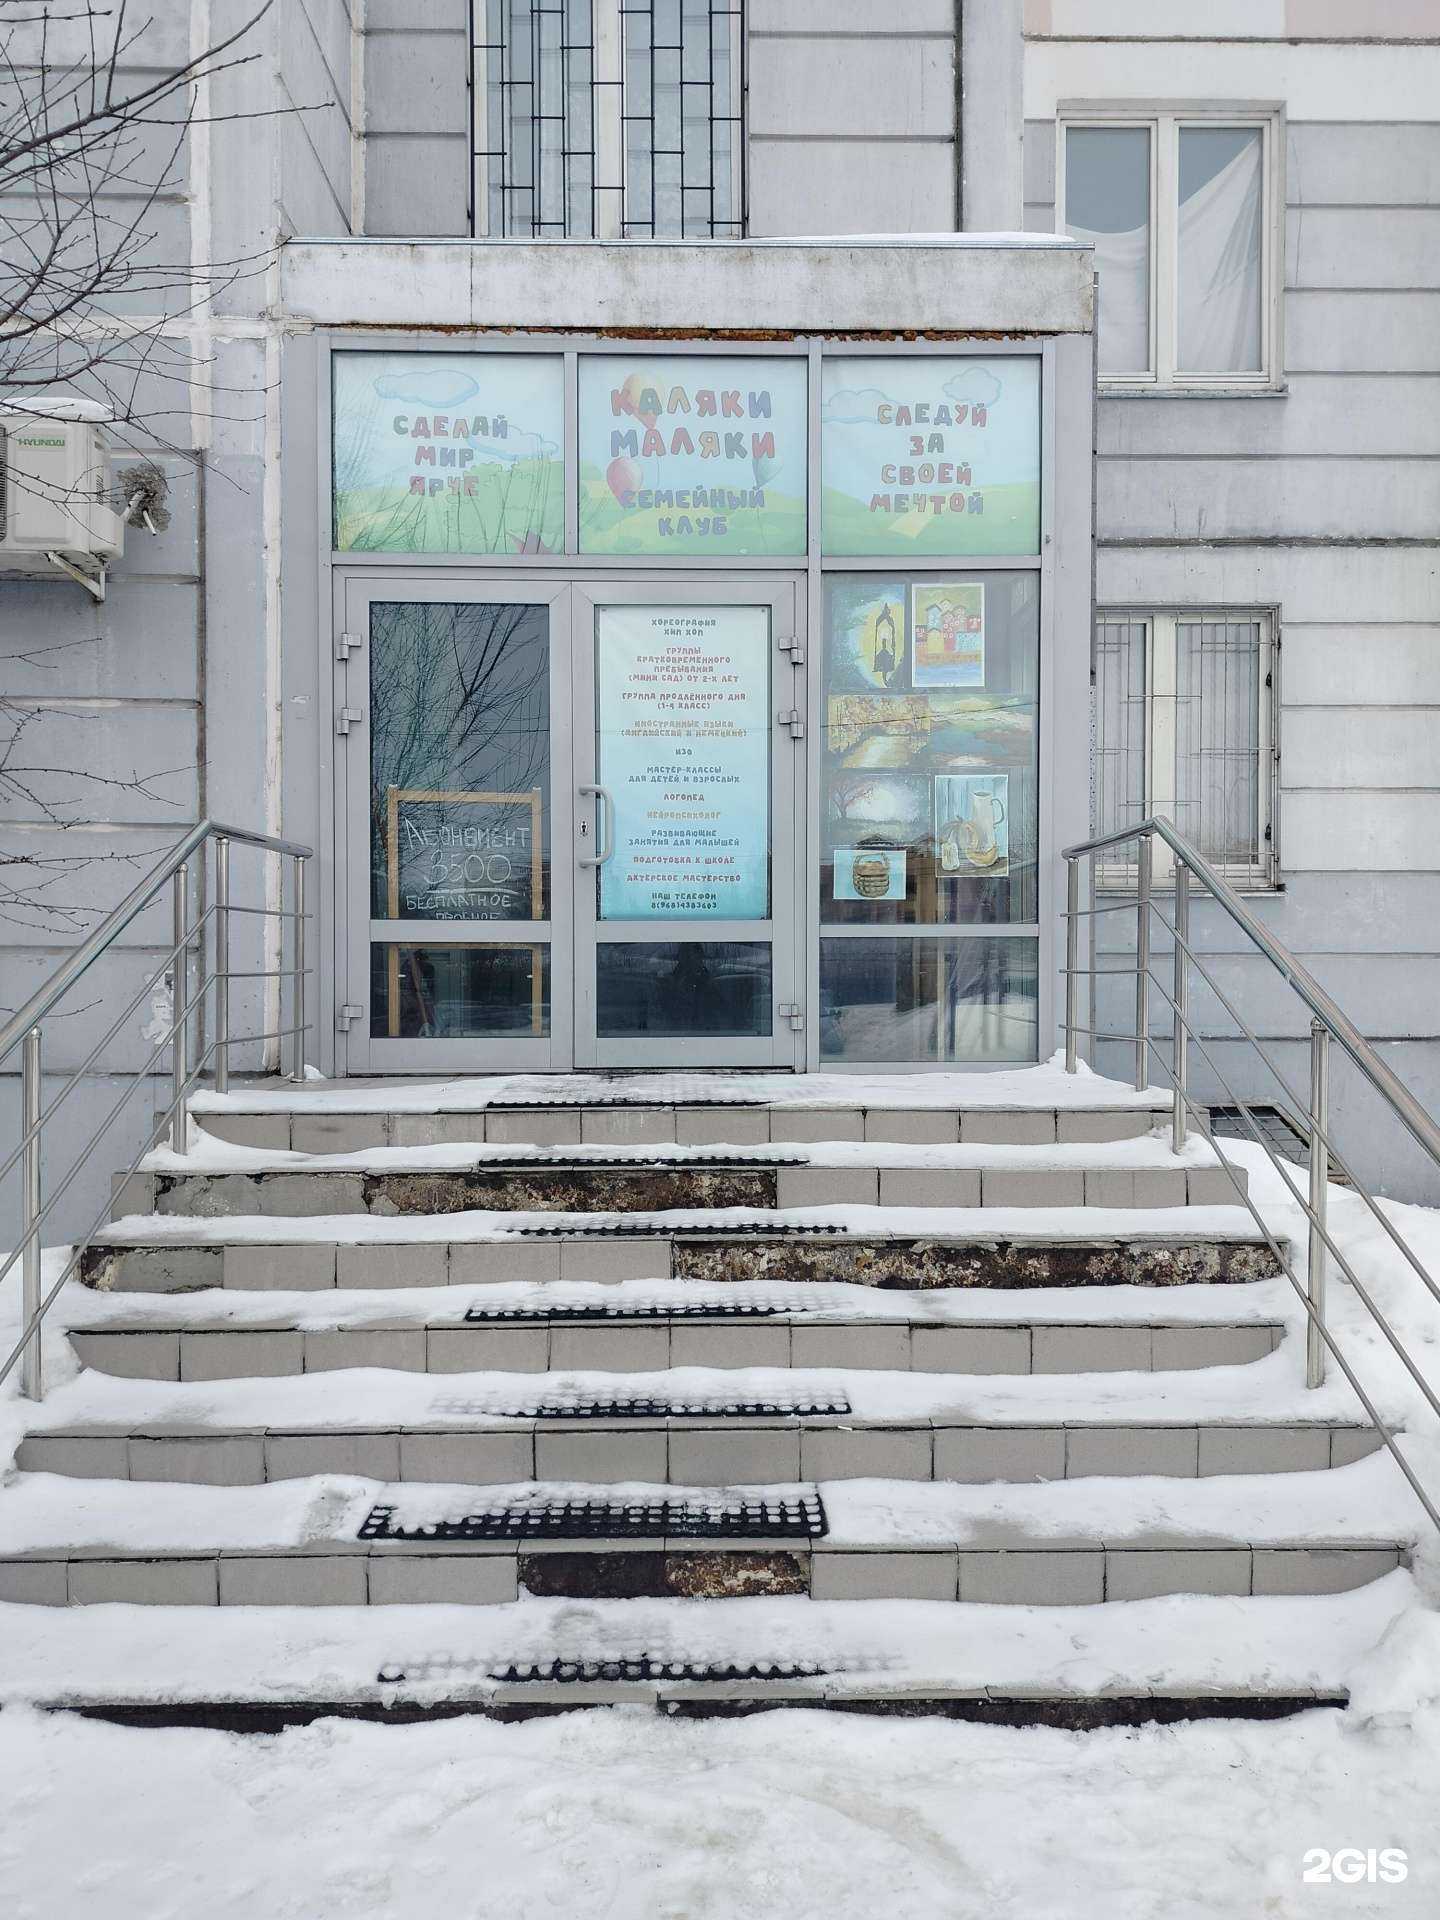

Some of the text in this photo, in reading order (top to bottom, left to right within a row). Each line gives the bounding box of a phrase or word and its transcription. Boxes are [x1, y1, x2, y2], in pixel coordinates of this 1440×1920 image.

[610, 386, 772, 418] КАЛЯКИ
[877, 403, 988, 427] СЛЕДУЙ
[393, 414, 508, 439] СДЕЛАЙ
[16, 438, 65, 446] HYUNDAI
[610, 427, 776, 459] МАЛЯКИ
[909, 432, 944, 456] ЗА
[414, 445, 474, 468] МИР
[881, 461, 972, 486] СВОЕЙ
[409, 475, 480, 498] ЯРЧЕ
[622, 485, 765, 509] СЕМЕЙНЫЙ
[869, 491, 984, 515] МЕЧТОЙ
[658, 515, 728, 537] КЛУБ
[651, 618, 717, 627] ХОРЕОГРАФИЯ
[664, 628, 704, 636] ХИП ХОП
[666, 647, 701, 655] ГРУППЫ
[636, 656, 731, 664] КРАТКОВРЕМЕННОГО
[654, 665, 714, 673] ПРЕБЫВАНИЯ
[628, 674, 658, 683] (МИНИ
[661, 674, 684, 683] САД)
[687, 674, 698, 683] ОТ
[721, 674, 739, 683] ЛЕТ
[622, 692, 656, 700] ГРУППА
[728, 692, 746, 700] ДНЯ
[657, 702, 711, 710] (1-4 КЛАСС)
[634, 720, 734, 728] ИНОСТРАННЫЕ ЯЗЫКИ
[686, 729, 692, 738] И
[675, 748, 693, 756] ИЗО
[646, 766, 722, 774] МАСТЕР-КЛАССЫ
[628, 775, 740, 783] ДЛЯ ДЕТЕЙ И ВЗРОСЛЫХ
[663, 793, 705, 802] ЛОГОПЕД
[647, 811, 721, 820] НЕЙРОПСИХОЛОГ
[628, 838, 740, 846] ЗАНЯТИЯ ДЛЯ МАЛЫШЕЙ
[633, 856, 735, 864] ПОДГОТОВКА К ШКОЛЕ
[424, 849, 512, 885] 3500
[626, 874, 741, 882] АКТЕРСКОЕ МАСТЕРСТВО
[651, 892, 717, 900] НАШ ТЕЛЕФОН
[405, 893, 512, 910] БЕСПЛАТНОЕ
